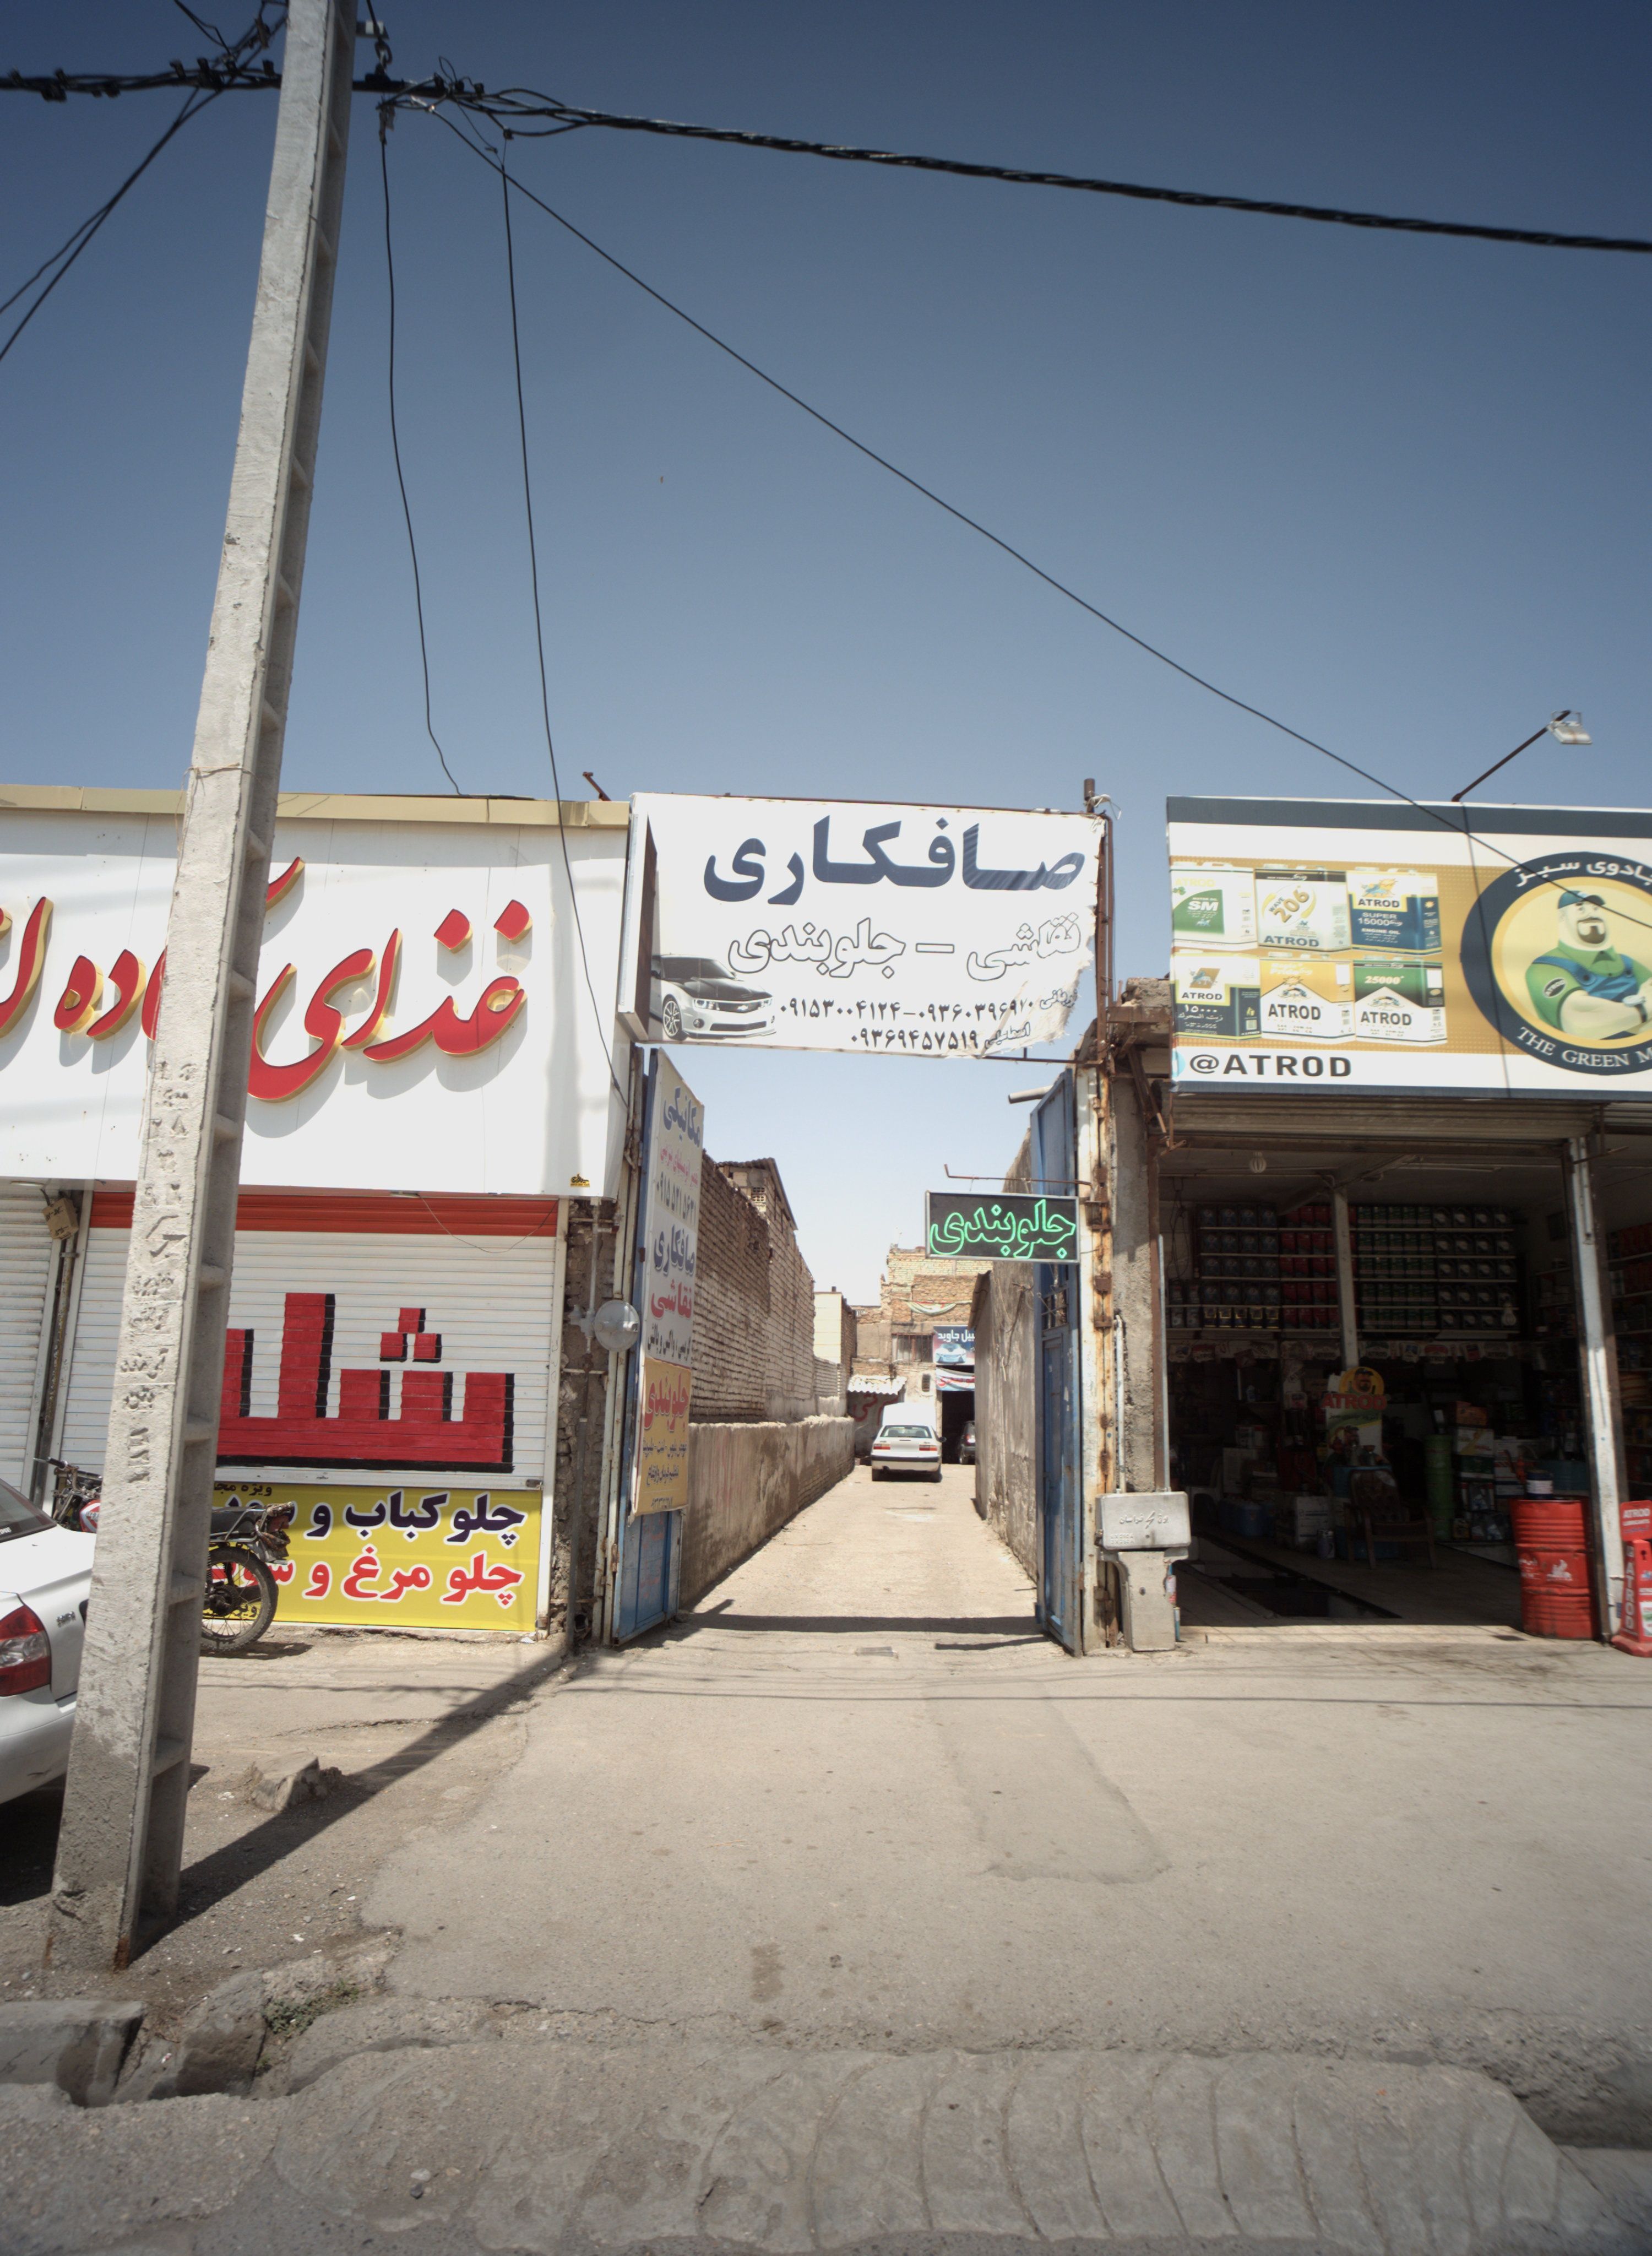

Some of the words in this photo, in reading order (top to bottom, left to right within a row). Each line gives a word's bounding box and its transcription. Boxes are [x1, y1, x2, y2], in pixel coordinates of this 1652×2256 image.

[704, 815, 1085, 905] صافکاری
[1514, 861, 1580, 887] سبز
[1187, 901, 1219, 911] SM
[1269, 897, 1285, 912] WAVE
[1273, 890, 1309, 923] 206
[1358, 898, 1400, 908] ATROD
[728, 917, 906, 979] جلوبندی
[967, 913, 1081, 982] نقاشی
[1264, 935, 1320, 947] ATROD
[248, 899, 531, 1102] غذای
[1182, 992, 1222, 1000] ATROD
[1268, 1004, 1321, 1020] ATROD
[1361, 1011, 1412, 1026] ATROD
[851, 1028, 978, 1050] ۰۹۳۶۹۴۵۷۵۱۹
[1517, 1027, 1556, 1055] THE
[1562, 1049, 1629, 1067] GREEN
[1189, 1053, 1352, 1079] @ATROD
[664, 1087, 701, 1148] مکانیکی
[930, 1198, 1076, 1259] جلوبندی
[654, 1224, 695, 1276] صافکاری
[651, 1278, 692, 1319] نقاشی
[938, 1329, 960, 1343] جاوید
[644, 1373, 688, 1432] جلوبندی
[1322, 1393, 1388, 1411] ATROD
[214, 1483, 236, 1494] مج
[241, 1483, 273, 1496] ویژه
[307, 1505, 330, 1537] و
[346, 1492, 447, 1537] کباب
[447, 1494, 524, 1545] چلو
[305, 1564, 330, 1597] و
[343, 1546, 431, 1603] مرغ
[442, 1553, 523, 1606] چلو
